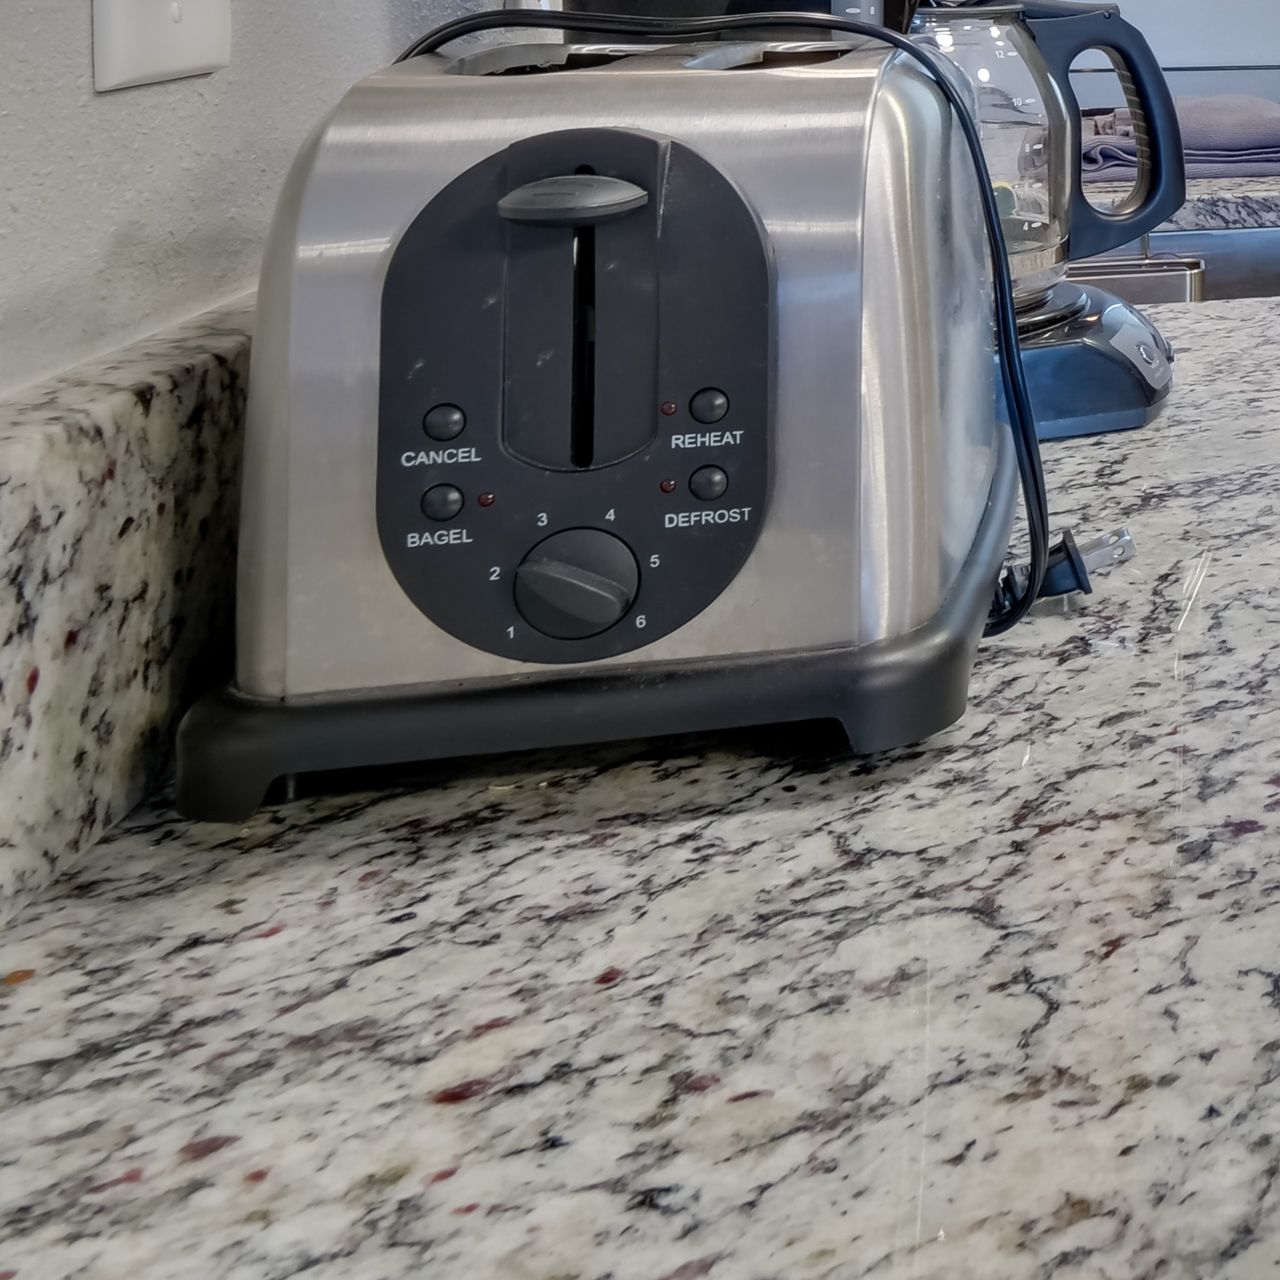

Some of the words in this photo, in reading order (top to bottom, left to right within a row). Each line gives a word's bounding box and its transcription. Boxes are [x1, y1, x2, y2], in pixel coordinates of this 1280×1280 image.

[995, 50, 1005, 59] 12
[1012, 97, 1022, 106] 10
[1025, 143, 1030, 152] 8
[1023, 222, 1028, 231] 4
[671, 431, 744, 449] REHEAT
[401, 448, 482, 467] CANCEL
[537, 513, 548, 526] 3
[605, 508, 616, 522] 4
[664, 507, 751, 528] DEFROST
[407, 529, 473, 548] BAGEL
[650, 554, 660, 567] 5
[489, 567, 500, 581] 2
[636, 615, 646, 628] 6
[507, 626, 515, 639] 1
